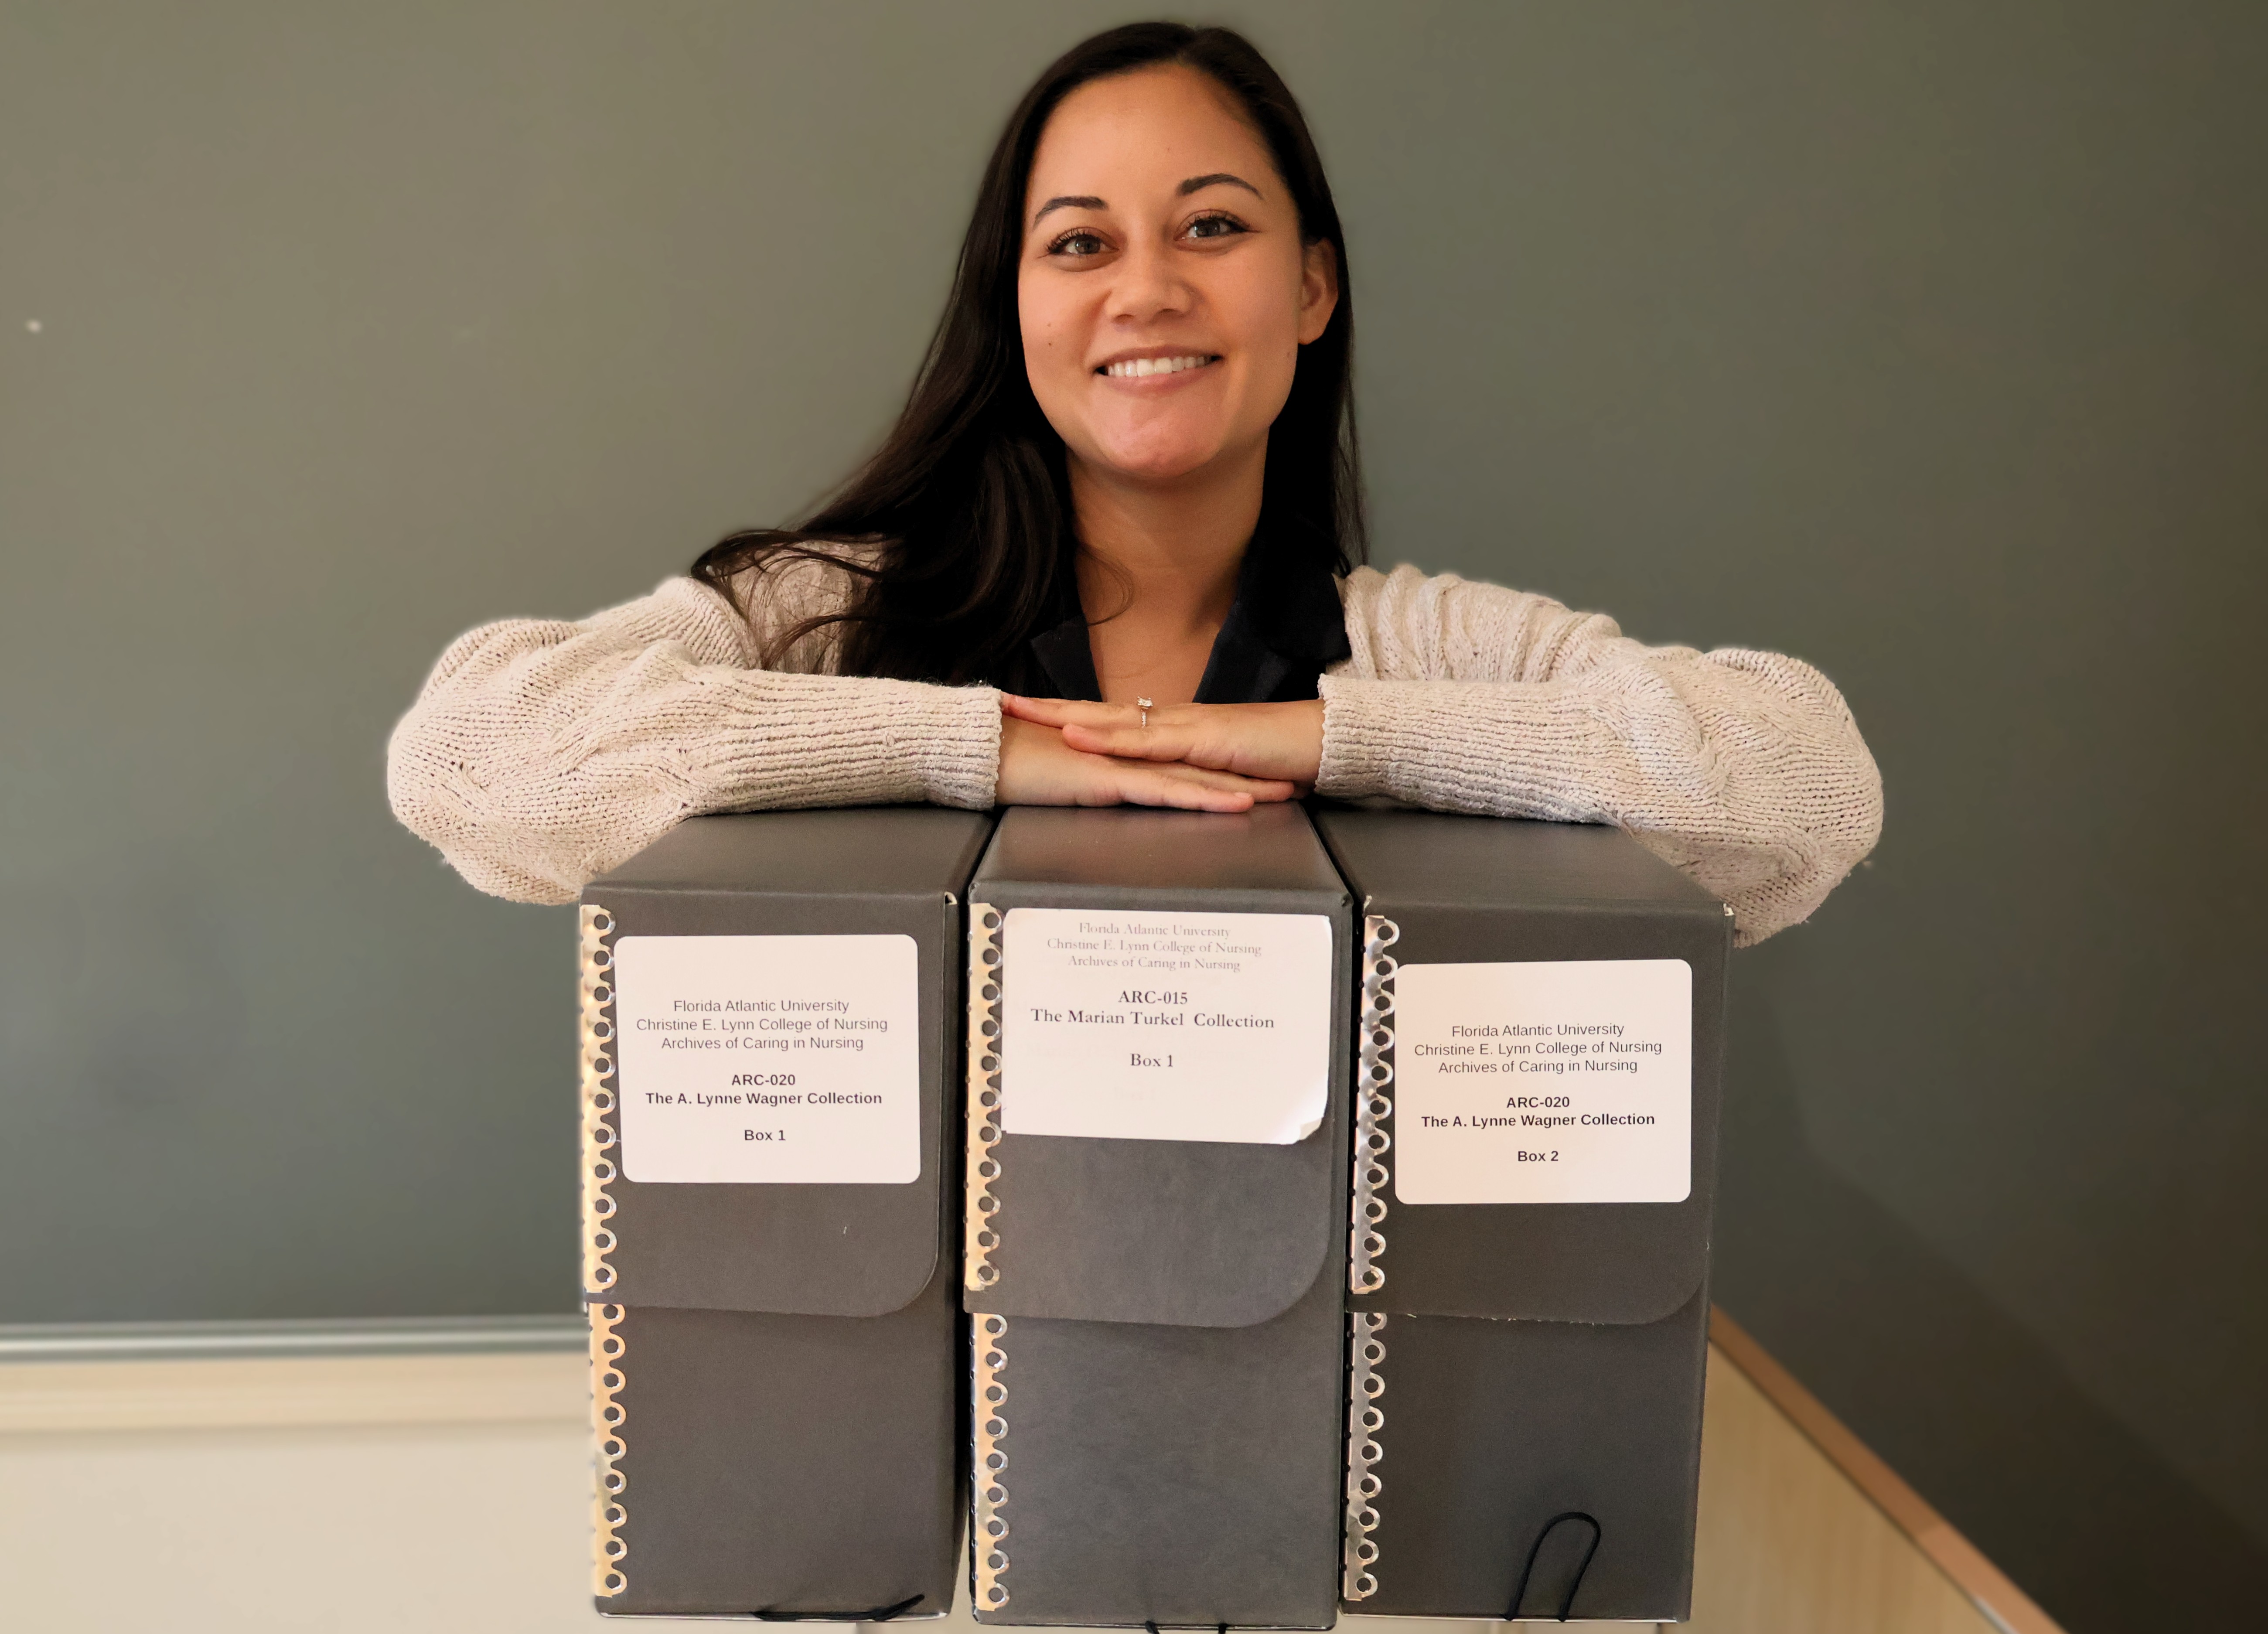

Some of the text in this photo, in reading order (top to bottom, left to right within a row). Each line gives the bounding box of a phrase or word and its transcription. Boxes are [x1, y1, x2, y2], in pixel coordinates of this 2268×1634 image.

[1079, 922, 1231, 940] Florida Atlantic University
[1047, 938, 1262, 957] Christine E. Lynn College of Nursing
[1068, 955, 1240, 973] Archives of Caring in Nursing
[1119, 990, 1187, 1004] ARC-015
[674, 999, 849, 1014] Florida Atlantic University
[636, 1017, 887, 1034] Christine E. Lynn College of Nursing
[1030, 1009, 1274, 1028] The Marian Turkel Collection
[1452, 1023, 1624, 1037] Florida Atlantic University
[661, 1036, 863, 1052] Archives of Caring in Nursing
[1414, 1041, 1662, 1057] Christine E. Lynn College of Nursing
[1131, 1053, 1173, 1067] Box 1
[1438, 1059, 1637, 1075] Archives of Caring in Nursing
[731, 1074, 795, 1086] ARC-020
[645, 1092, 882, 1107] The A. Lynne Wagner Collection
[1506, 1096, 1570, 1108] ARC-020
[1421, 1113, 1655, 1129] The A. Lynne Wagner Collection
[744, 1129, 786, 1141] Box 1
[1518, 1150, 1559, 1162] Box 2
